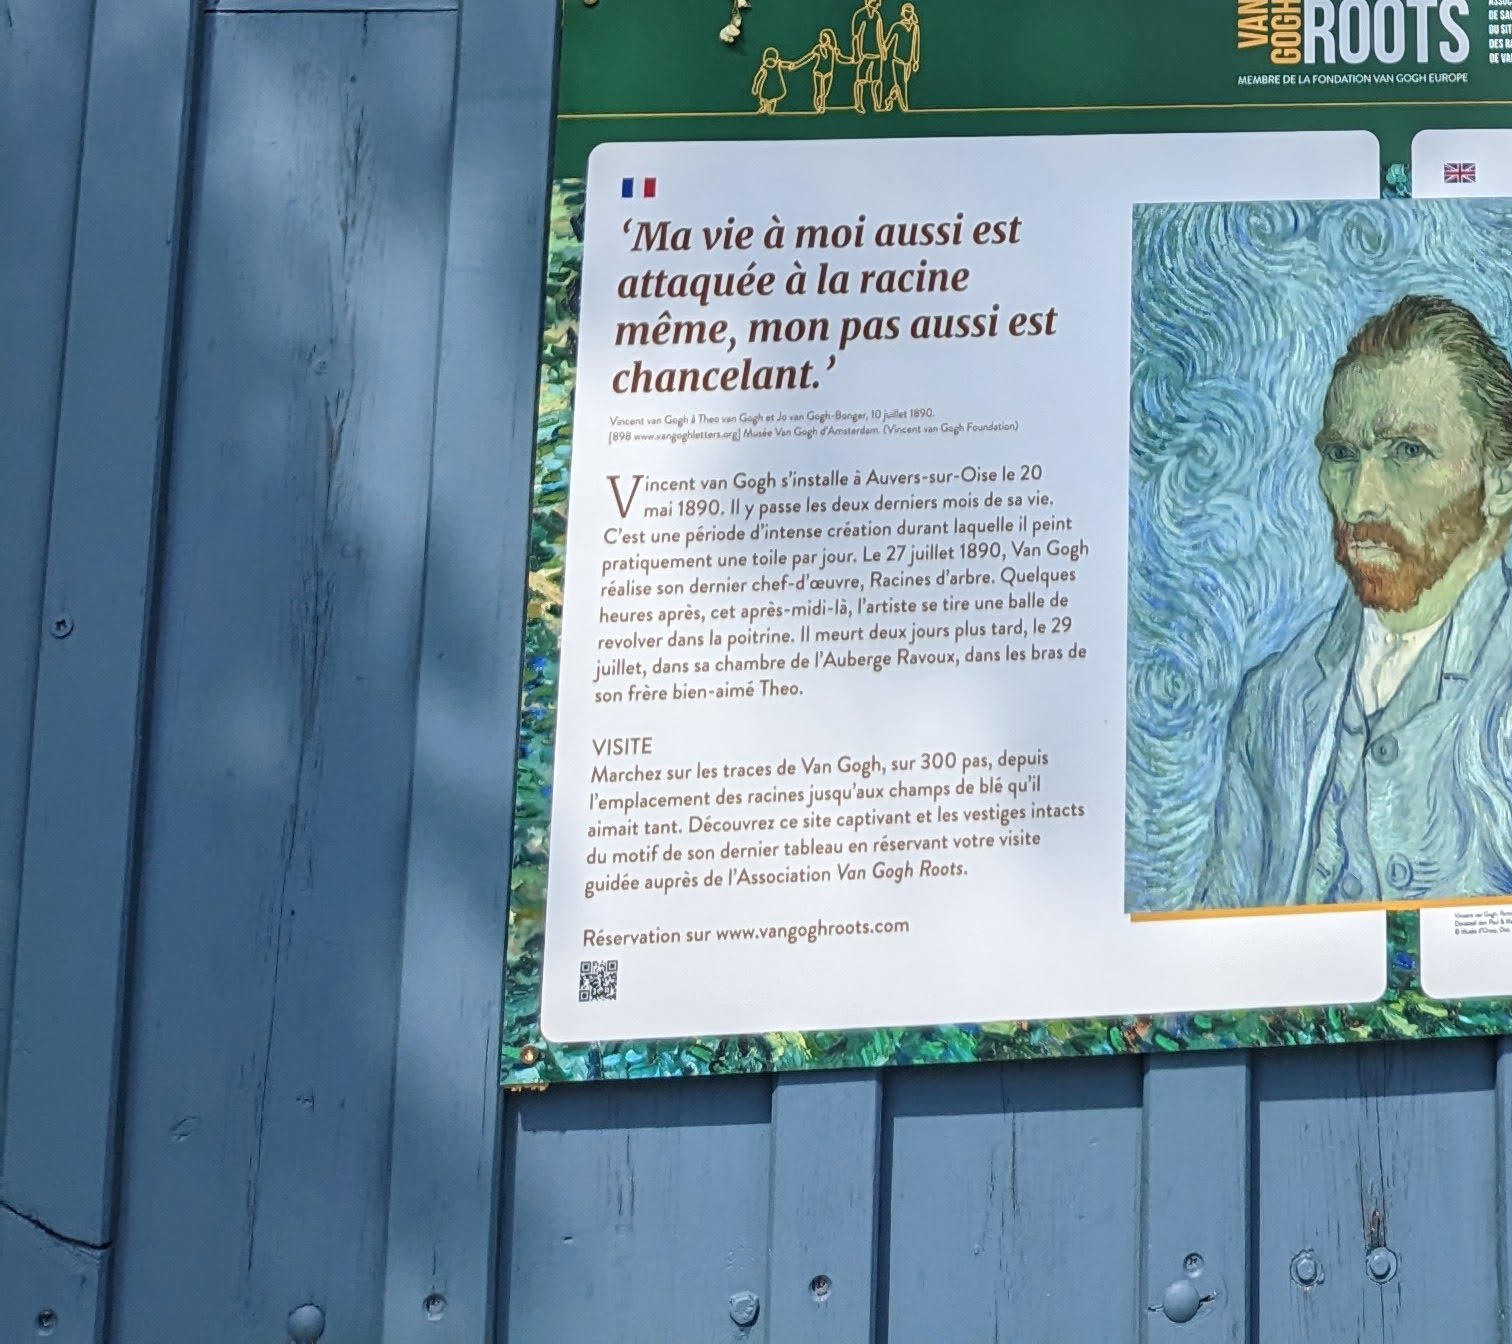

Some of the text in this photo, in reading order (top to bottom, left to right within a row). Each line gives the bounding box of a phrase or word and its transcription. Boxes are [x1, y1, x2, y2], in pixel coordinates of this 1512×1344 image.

[1488, 9, 1499, 21] DE
[1488, 23, 1500, 35] DU
[1488, 37, 1504, 50] DES
[1488, 52, 1500, 64] DE
[1237, 72, 1468, 85] MEMBRE DE LA FONDATION VAN GOGH EUROPE
[702, 216, 754, 250] vie
[763, 214, 785, 249] à
[795, 214, 866, 249] moi
[874, 212, 964, 247] aussi
[972, 216, 1022, 245] est
[617, 258, 970, 307] attaquée à la racine
[614, 303, 1058, 353] même, mon pas aussi est
[607, 474, 695, 519] Vincent
[700, 479, 727, 490] van
[732, 470, 776, 495] Gogh
[853, 469, 861, 486] à
[865, 465, 997, 486] Auvers-sur-Oise
[1002, 464, 1015, 482] le
[1019, 464, 1042, 482] 20
[643, 488, 1053, 521] mai 1890. Il y passe les deux derniers mois de sa vie.
[591, 736, 653, 756] VISITE
[590, 748, 1049, 783] Marchez sur les traces de Van Gogh, sur 300 pas, depuis
[586, 828, 1041, 865] du motif de son dernier tableau en réservant votre visite
[583, 918, 909, 947] Réservation sur www.vangoghroots.com
